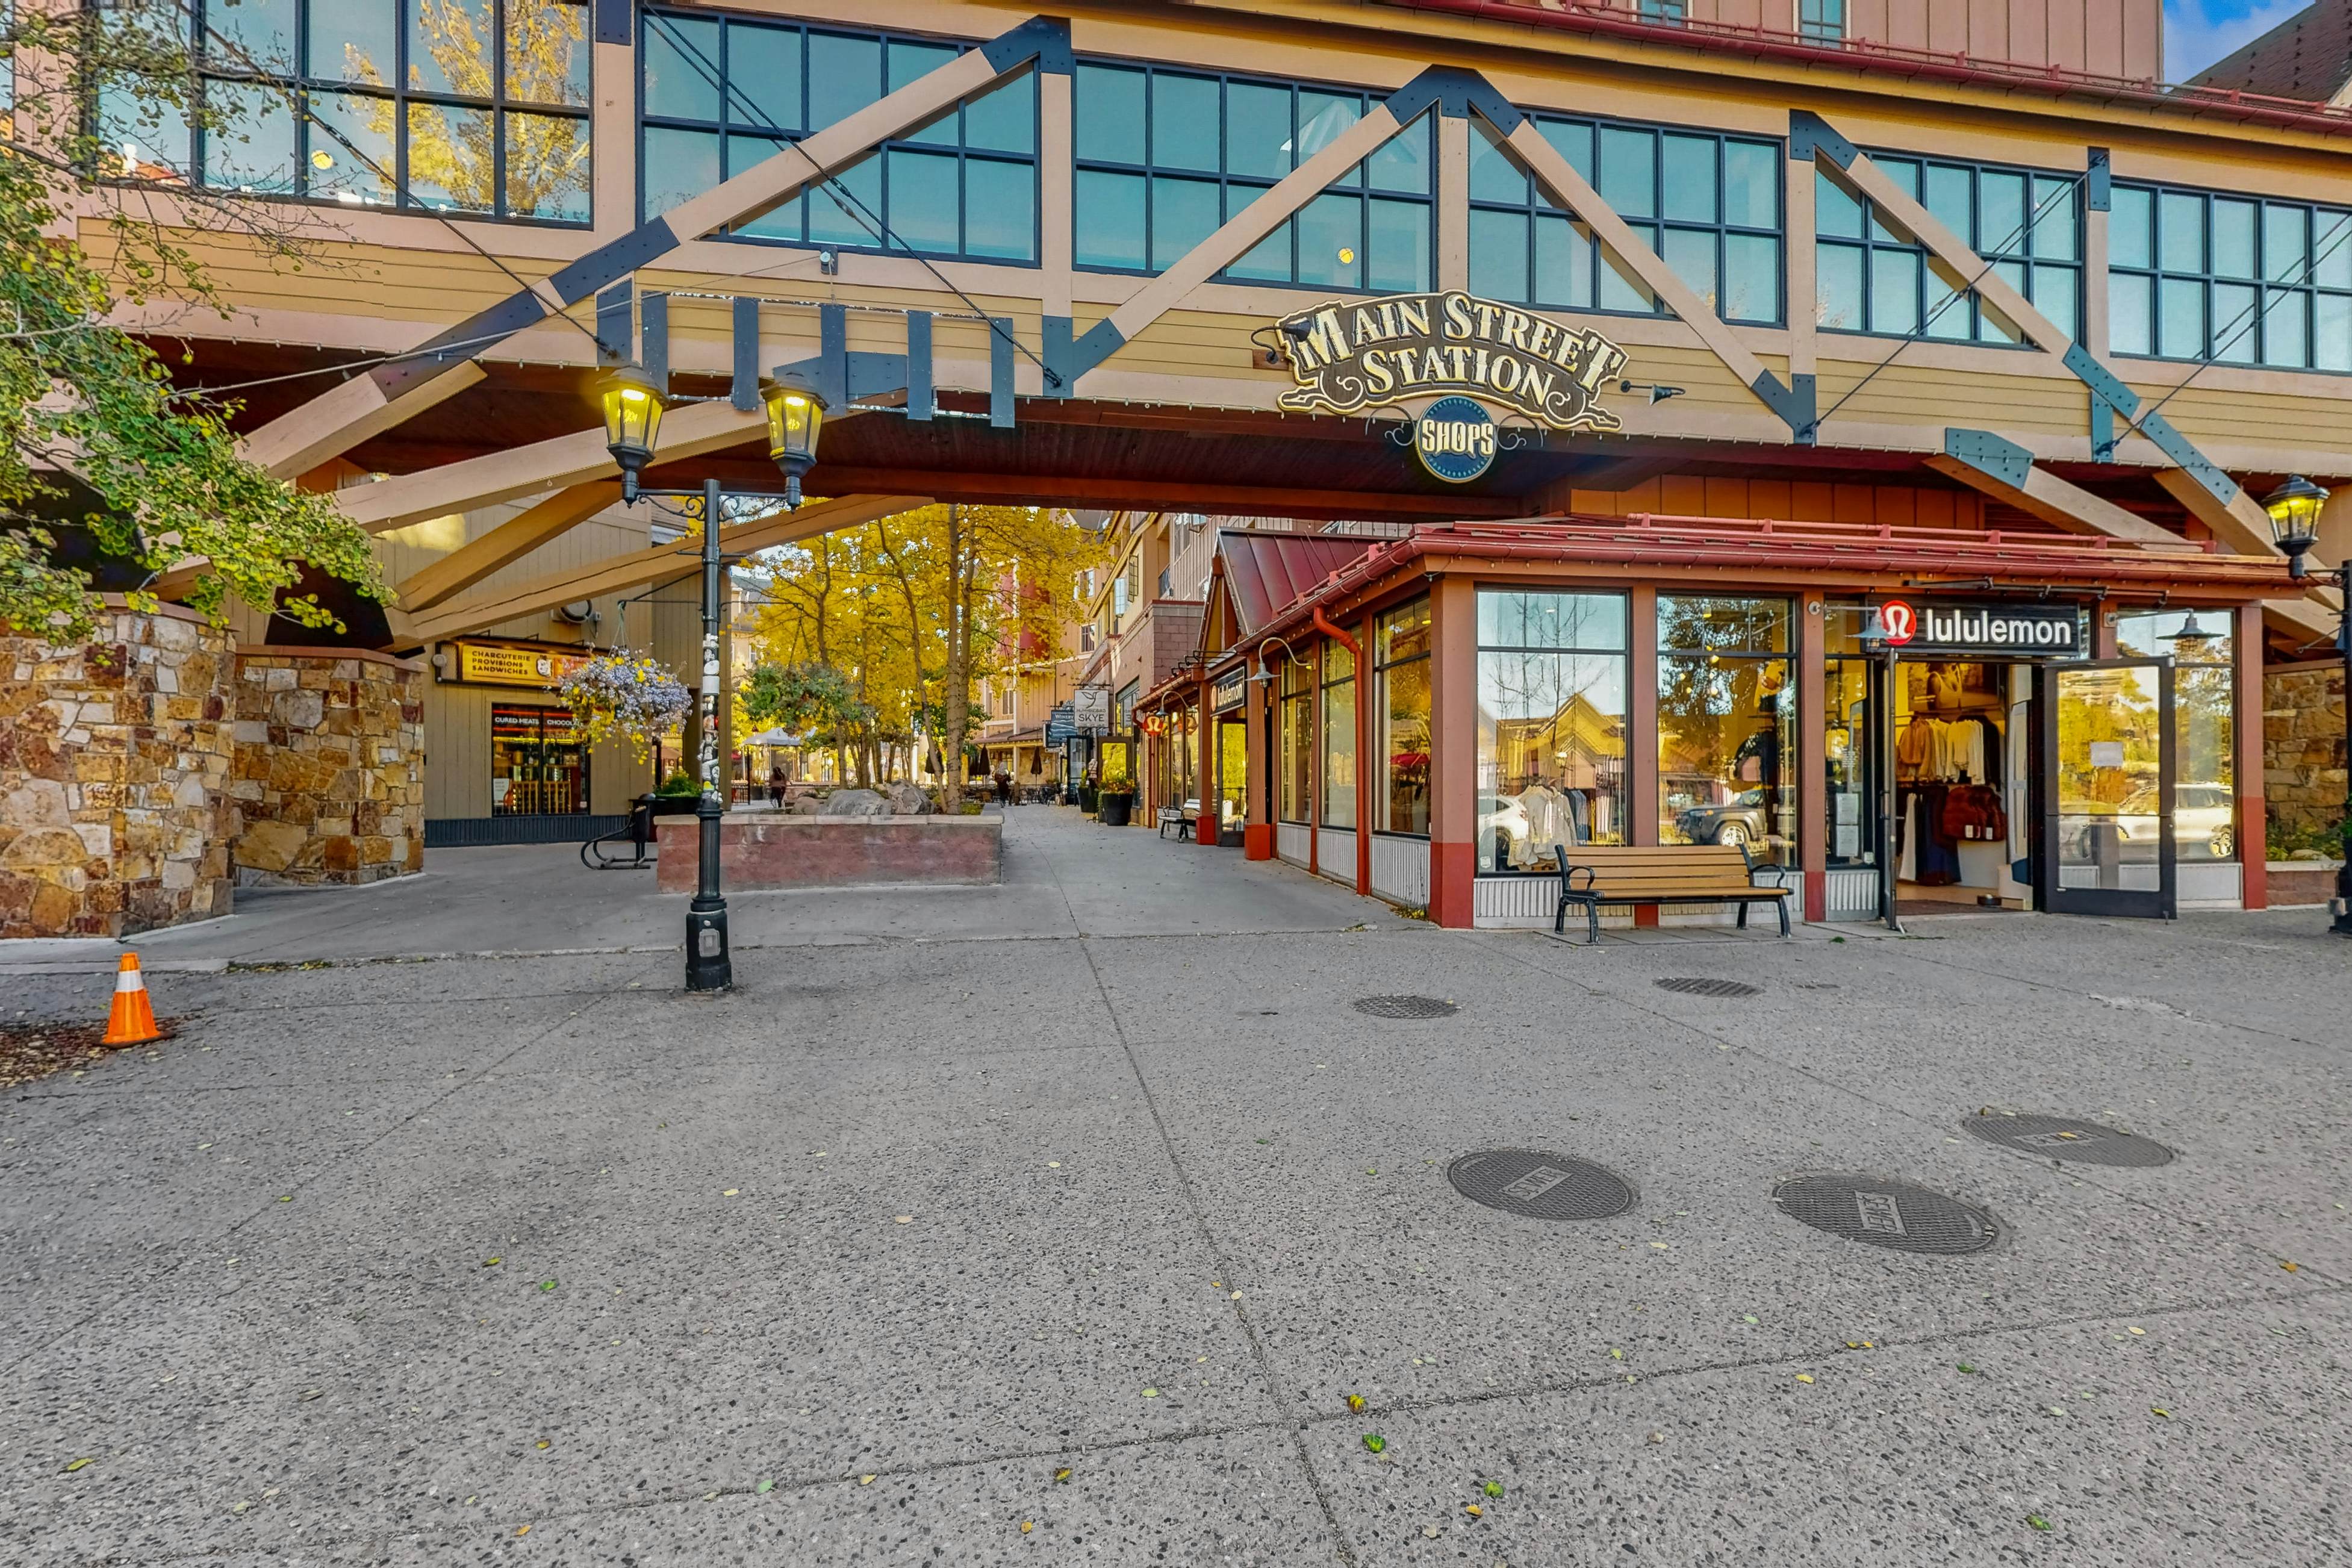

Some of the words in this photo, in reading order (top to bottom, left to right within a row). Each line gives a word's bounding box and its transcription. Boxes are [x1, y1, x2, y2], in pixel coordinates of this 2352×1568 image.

[1292, 299, 1430, 372] MAIN
[1445, 293, 1623, 394] STREET
[1362, 345, 1555, 406] STATION
[1421, 418, 1495, 458] SHOPS
[1926, 608, 2071, 645] lululemon
[471, 650, 530, 661] CHARCUTERIE
[471, 658, 523, 668] PROVISIONS
[471, 665, 528, 675] SANDWICHES
[1217, 683, 1242, 707] lululemon
[1078, 714, 1105, 722] SKYE
[1507, 1168, 1558, 1197] SEWER
[1861, 1195, 1897, 1232] SEWER
